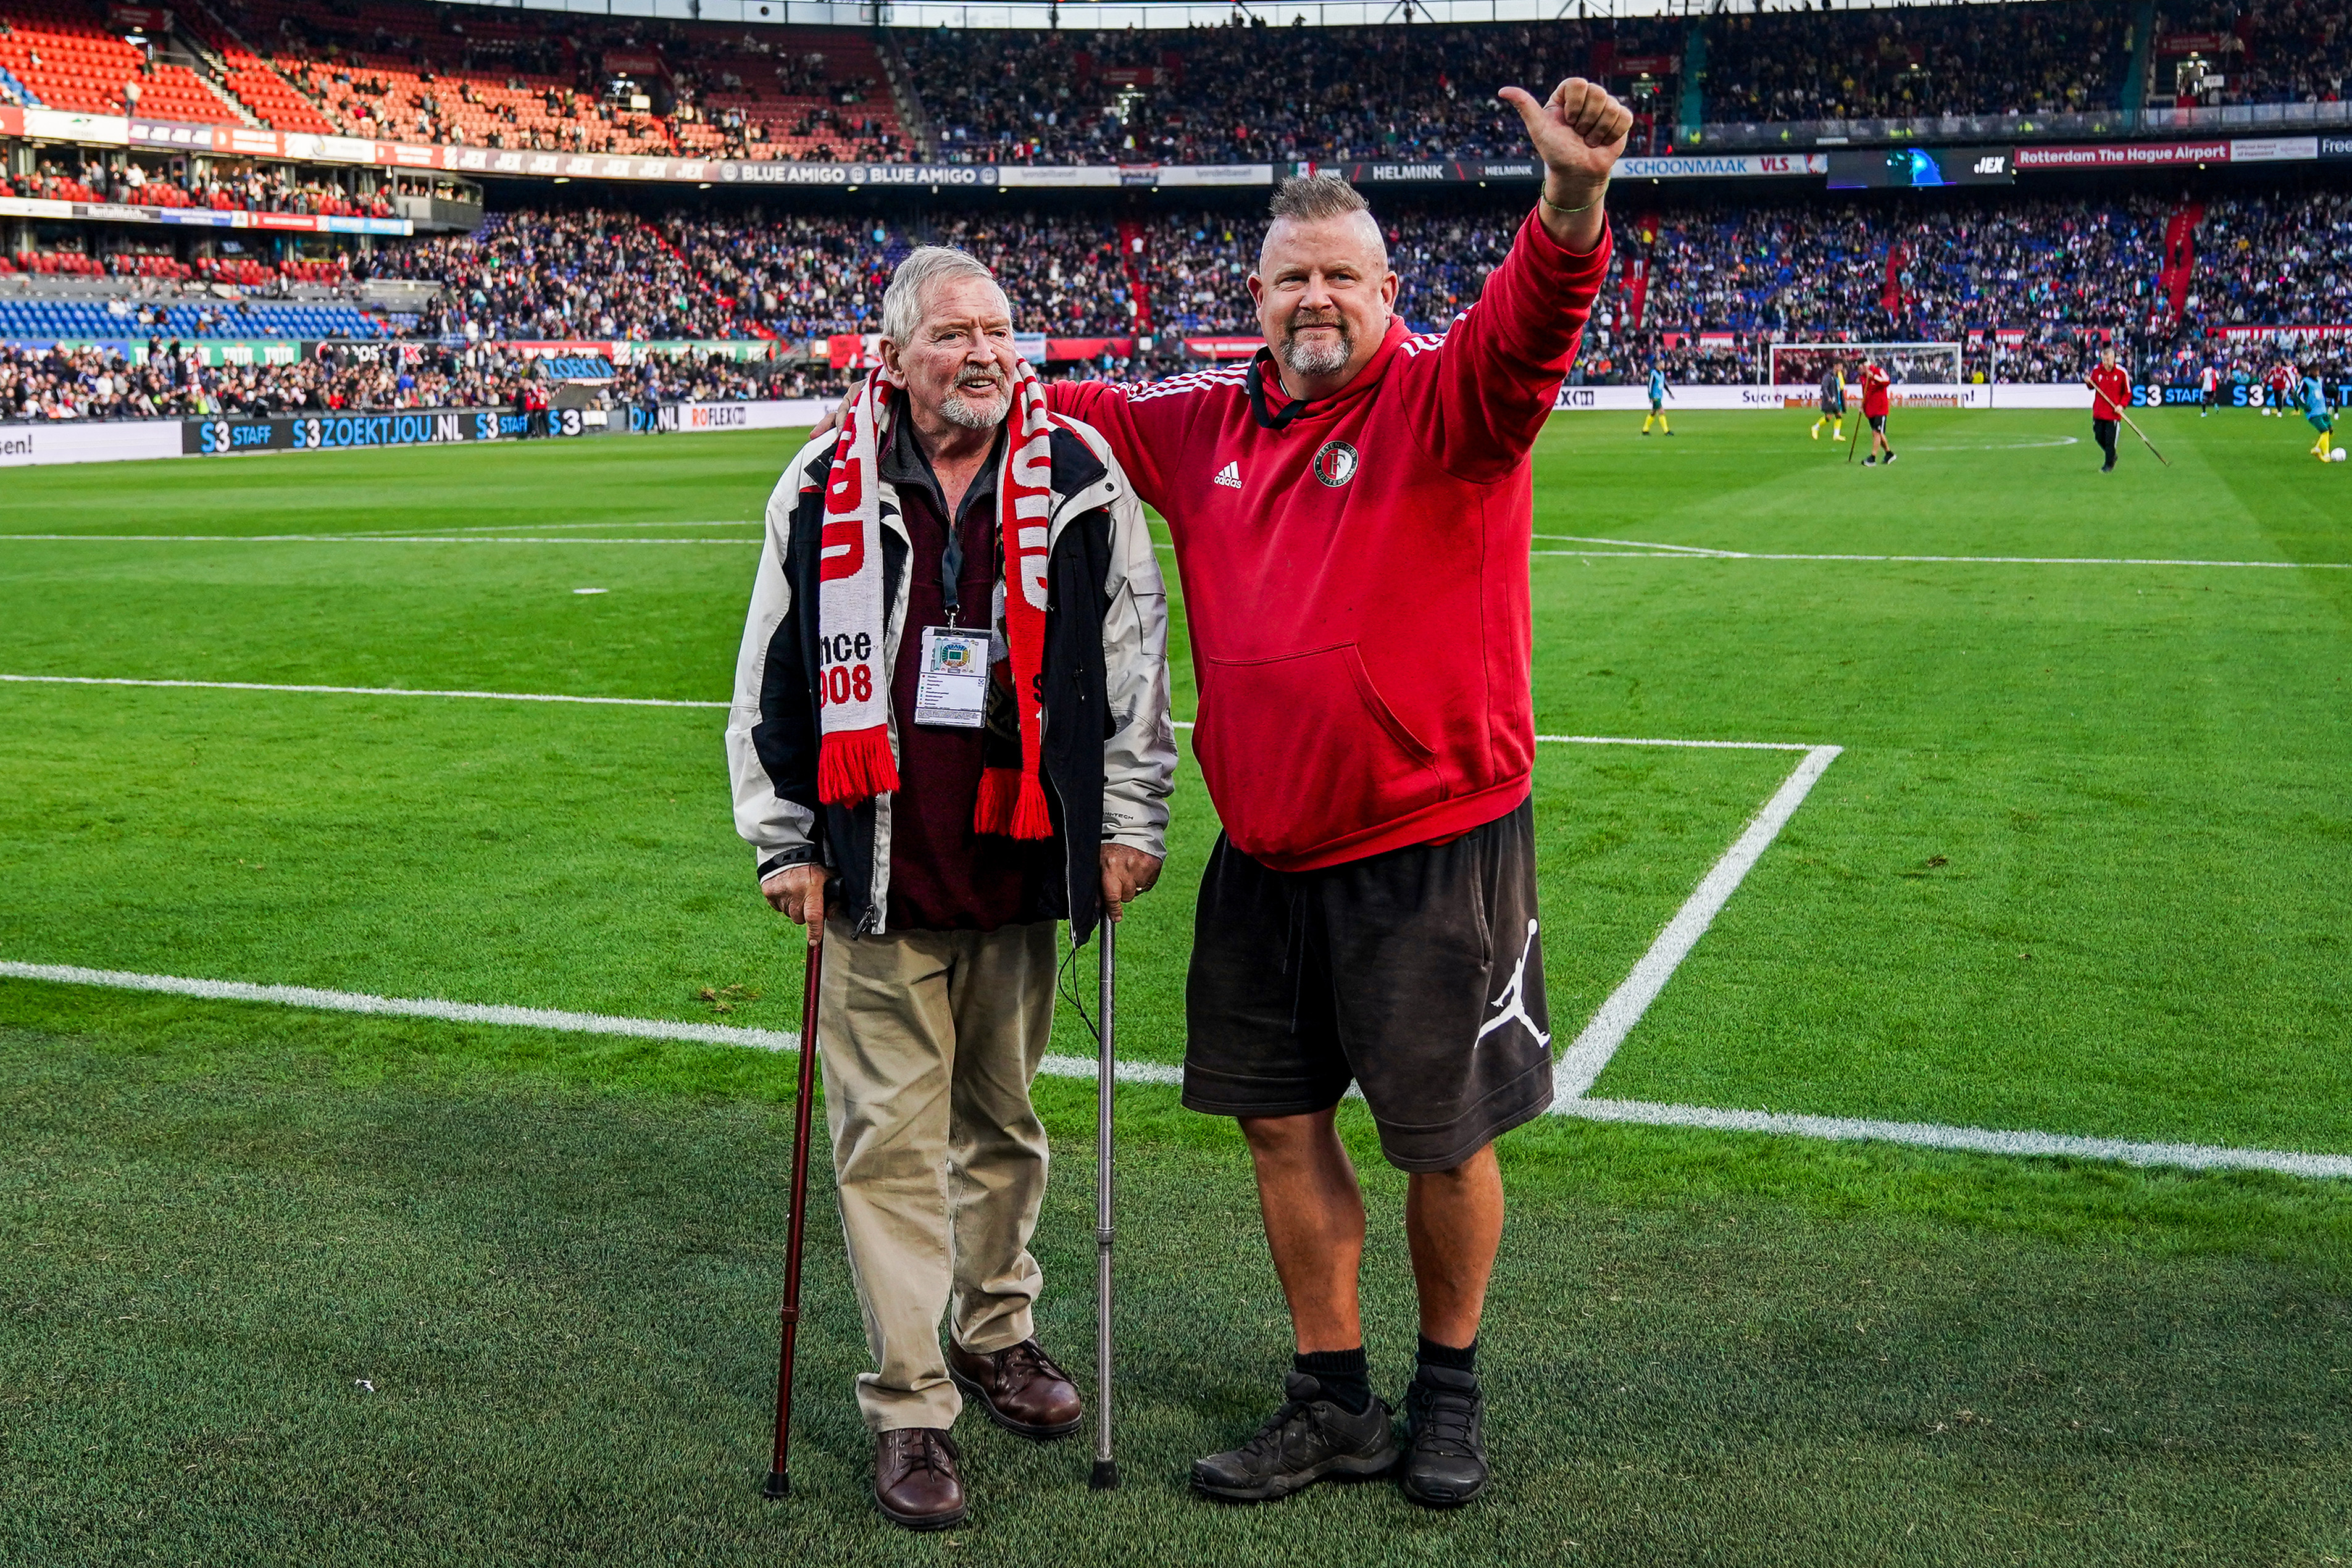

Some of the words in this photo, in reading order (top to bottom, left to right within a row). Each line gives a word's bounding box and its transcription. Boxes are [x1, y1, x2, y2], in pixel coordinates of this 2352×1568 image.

[2020, 151, 2096, 164] Rotterdam
[2098, 149, 2124, 162] The
[2127, 147, 2173, 163] Hague
[2175, 144, 2227, 160] Airport
[743, 165, 785, 181] BLUE
[788, 165, 846, 183] AMIGO
[1372, 165, 1444, 180] HELMINK
[1485, 165, 1533, 177] HELMINK
[1624, 157, 1747, 175] SCHOONMAAK
[1760, 157, 1789, 172] VLS
[1974, 157, 2005, 173] JEX
[870, 167, 915, 183] BLUE
[917, 167, 976, 183] AMIGO
[2132, 384, 2162, 408] S3
[476, 412, 499, 440] S3
[499, 415, 528, 434] STAF
[691, 407, 733, 427] ROFLEX
[0, 434, 33, 455] en!
[200, 420, 231, 452] S3
[232, 425, 272, 446] STAFF
[1214, 474, 1243, 490] adidas
